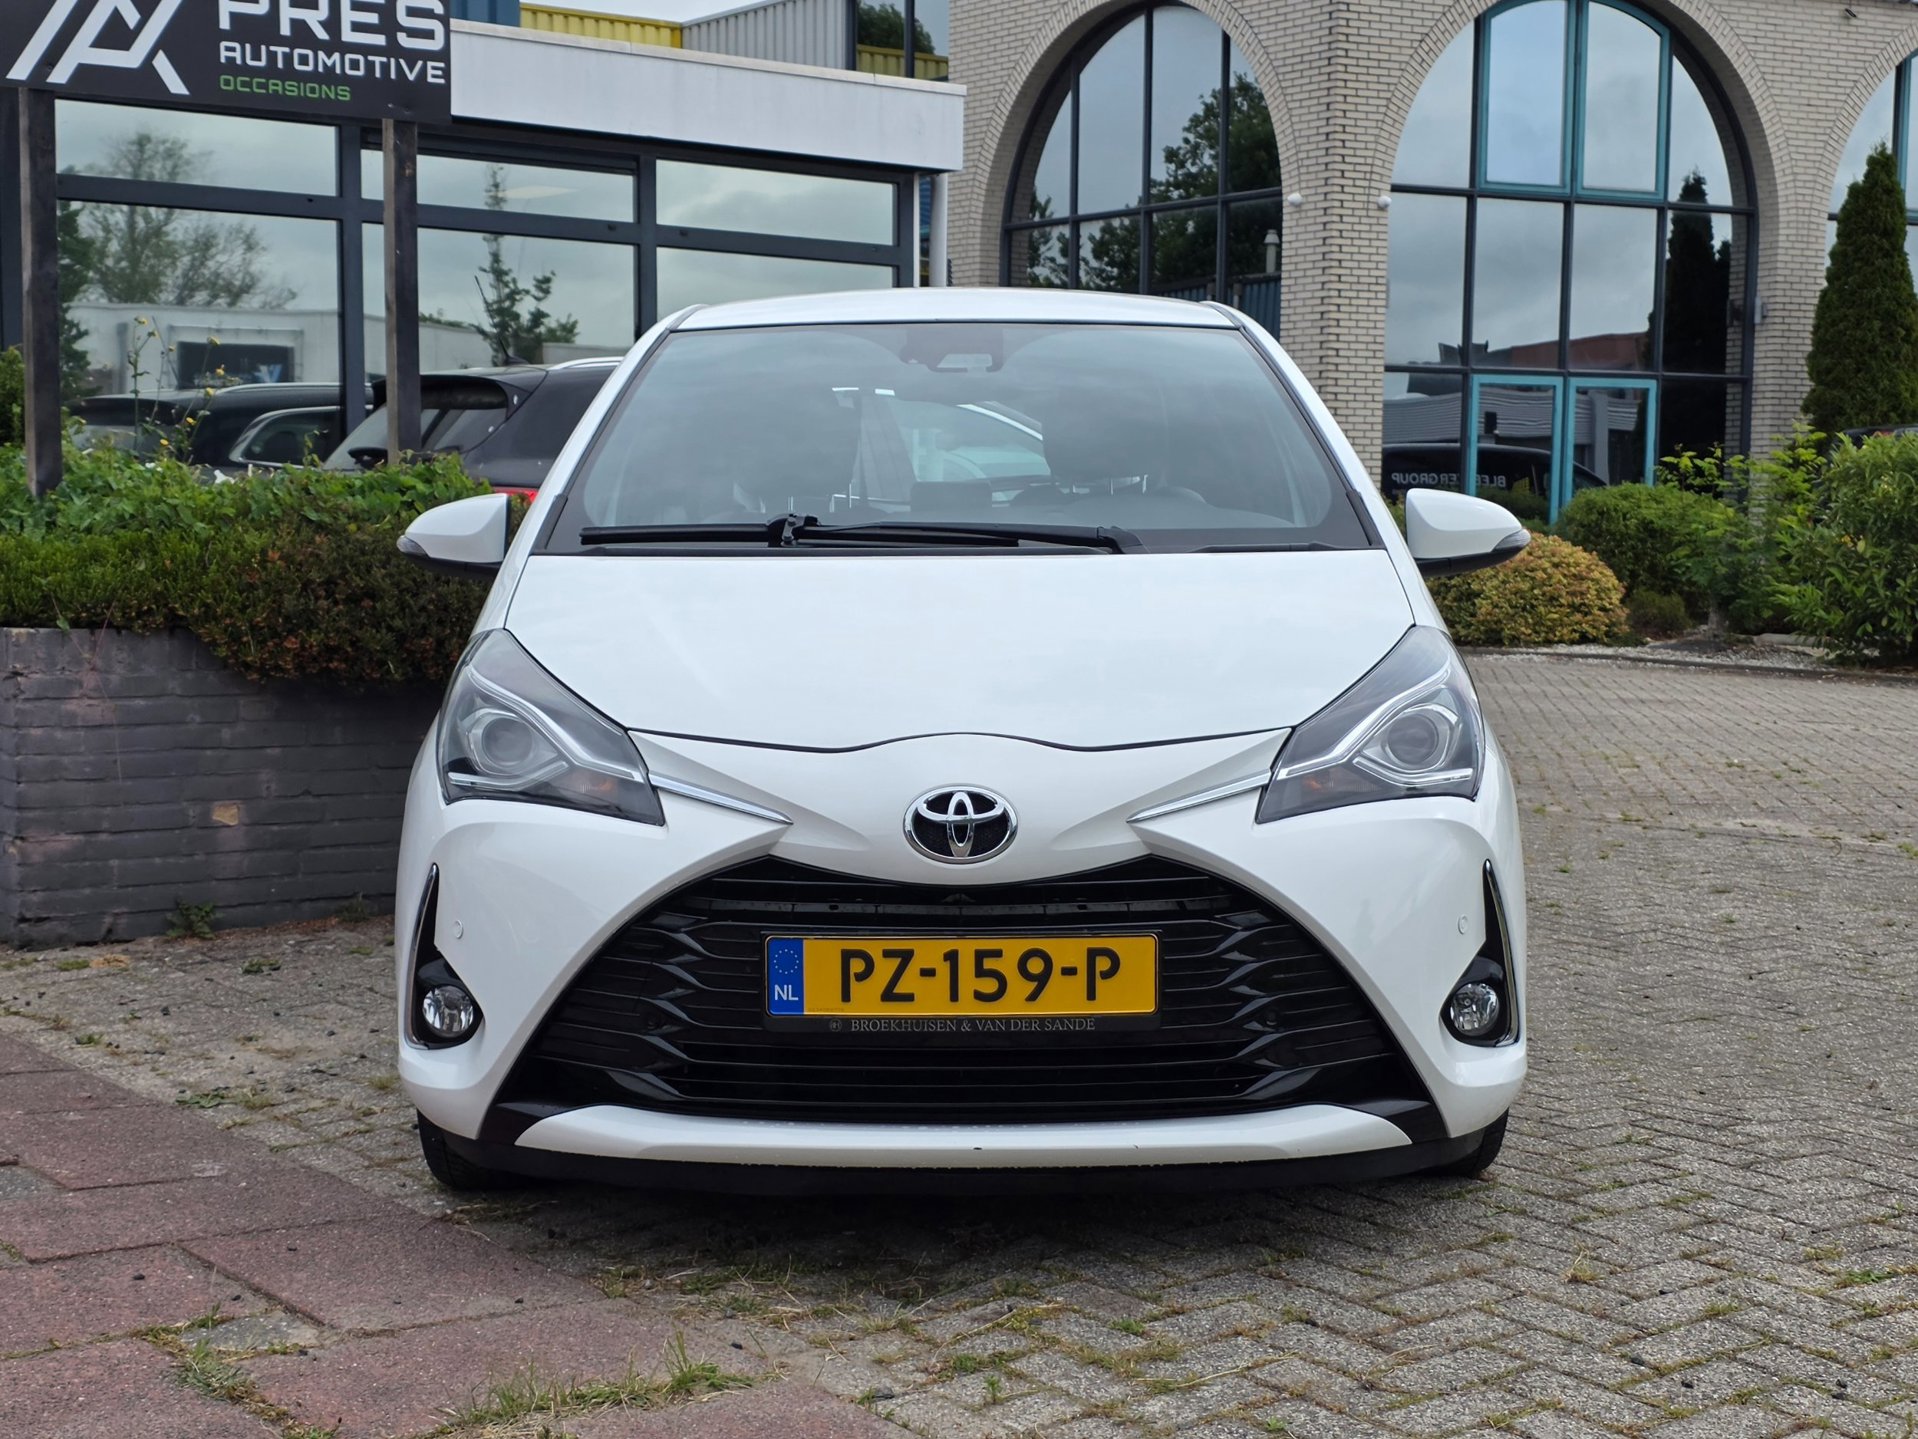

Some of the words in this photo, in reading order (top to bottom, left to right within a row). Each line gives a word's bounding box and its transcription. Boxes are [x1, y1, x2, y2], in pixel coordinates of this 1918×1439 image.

[218, 0, 446, 51] PRES
[218, 41, 446, 84] AUTOMOTIVE
[219, 75, 352, 101] OCCASIONS
[840, 947, 1121, 1003] PZ-159-P
[774, 984, 799, 1001] NL
[851, 1019, 957, 1032] BROEKHUISEN
[961, 1019, 972, 1032] &
[976, 1019, 1008, 1032] VAN
[1010, 1019, 1042, 1032] DER
[1044, 1018, 1096, 1031] SANDE
